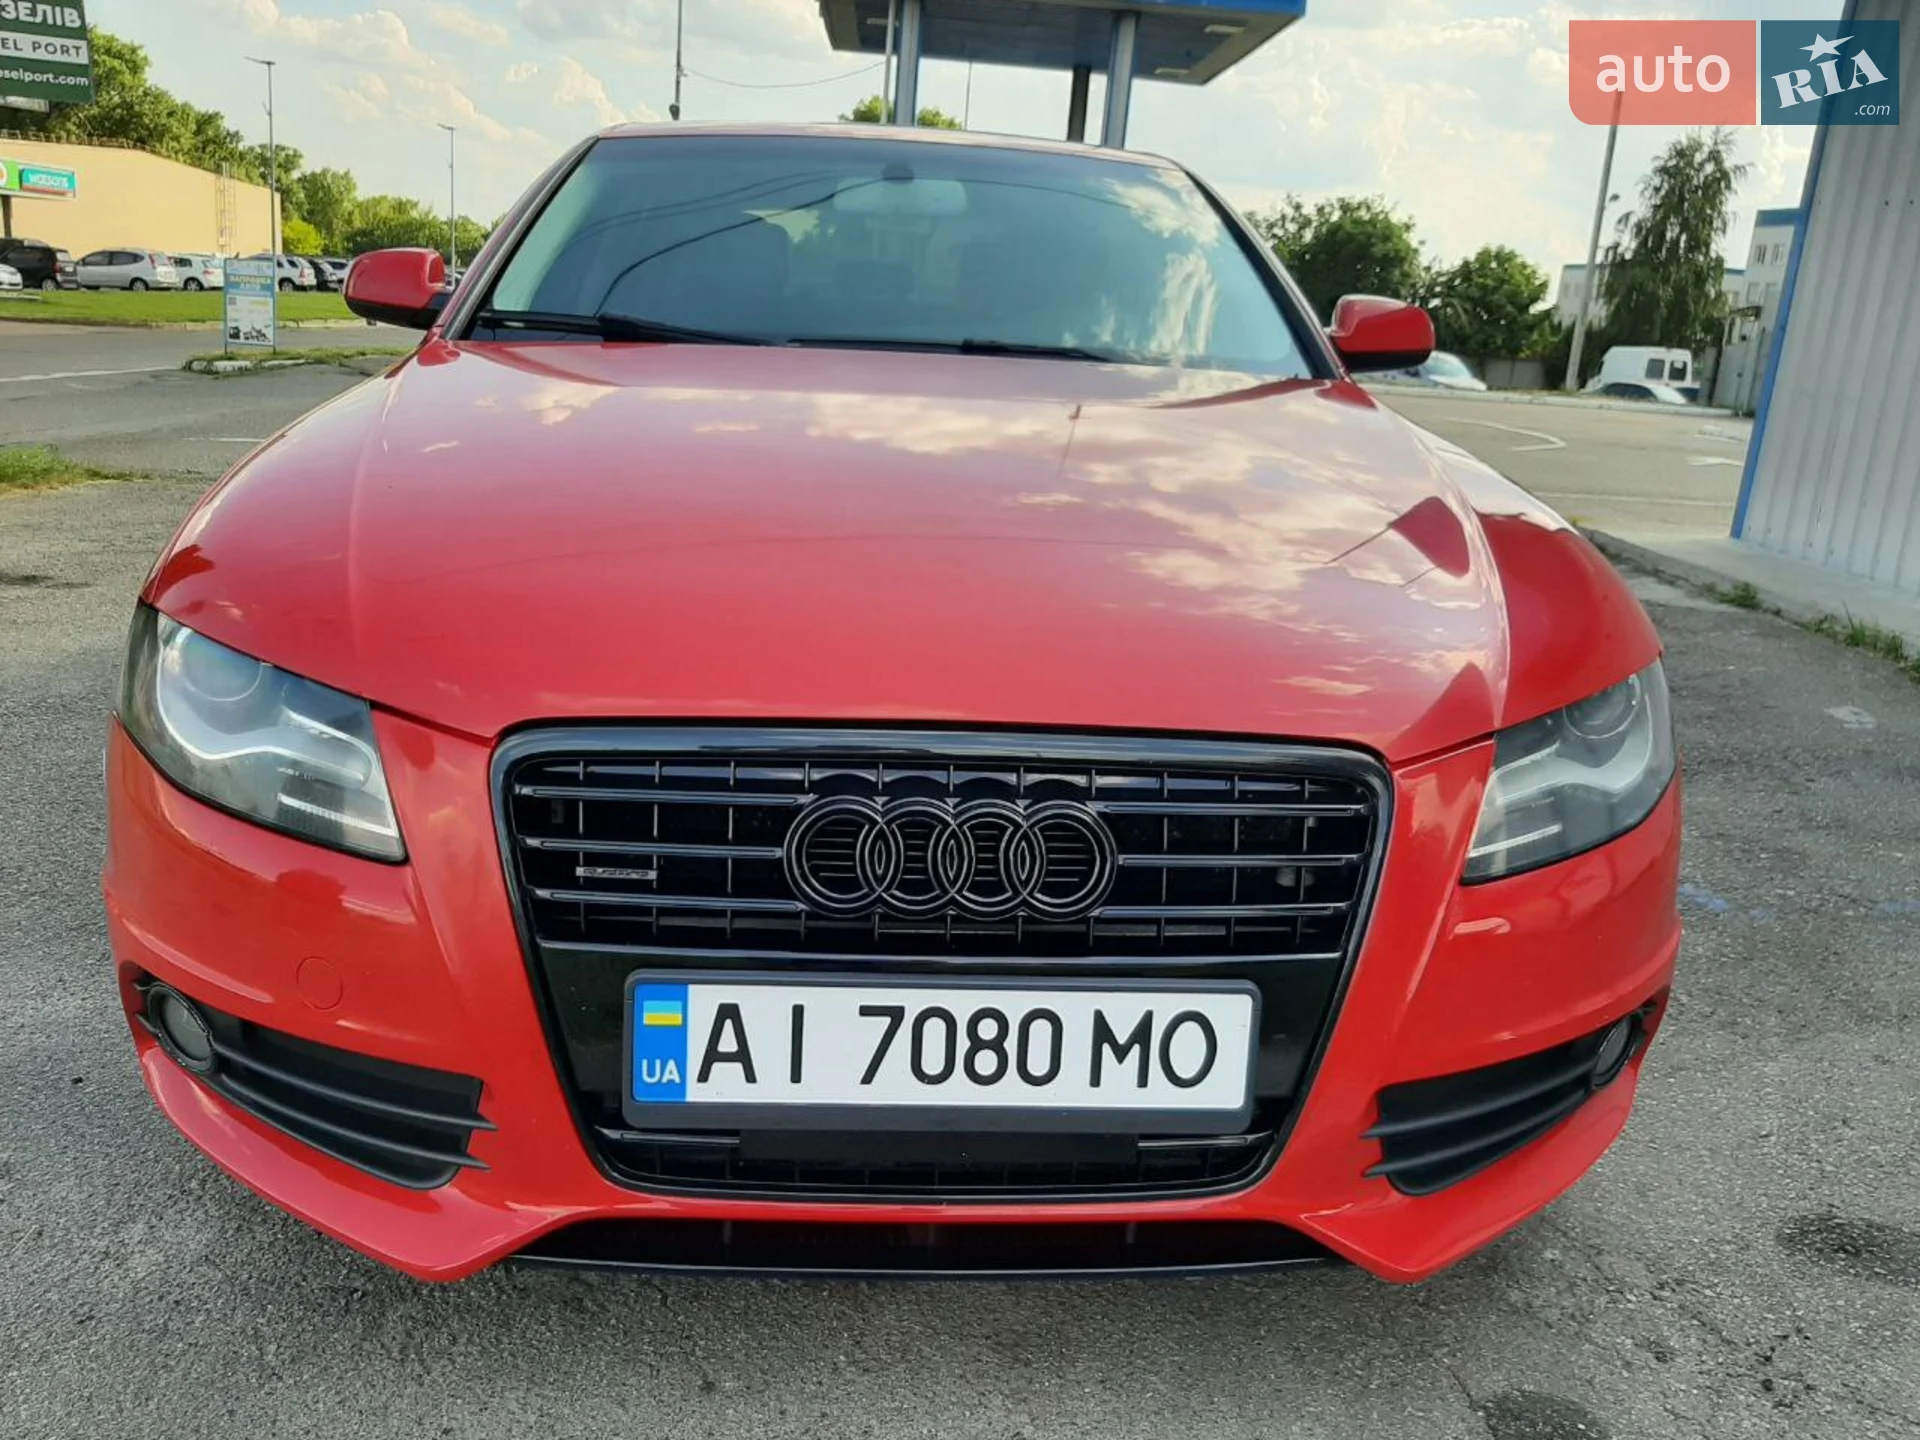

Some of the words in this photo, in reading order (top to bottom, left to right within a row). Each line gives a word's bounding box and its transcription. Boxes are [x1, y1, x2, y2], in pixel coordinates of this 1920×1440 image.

[1, 37, 23, 52] EL
[32, 41, 82, 58] PORT
[858, 1004, 1064, 1087] 7080
[1089, 1008, 1218, 1089] MO
[641, 1059, 681, 1085] UA
